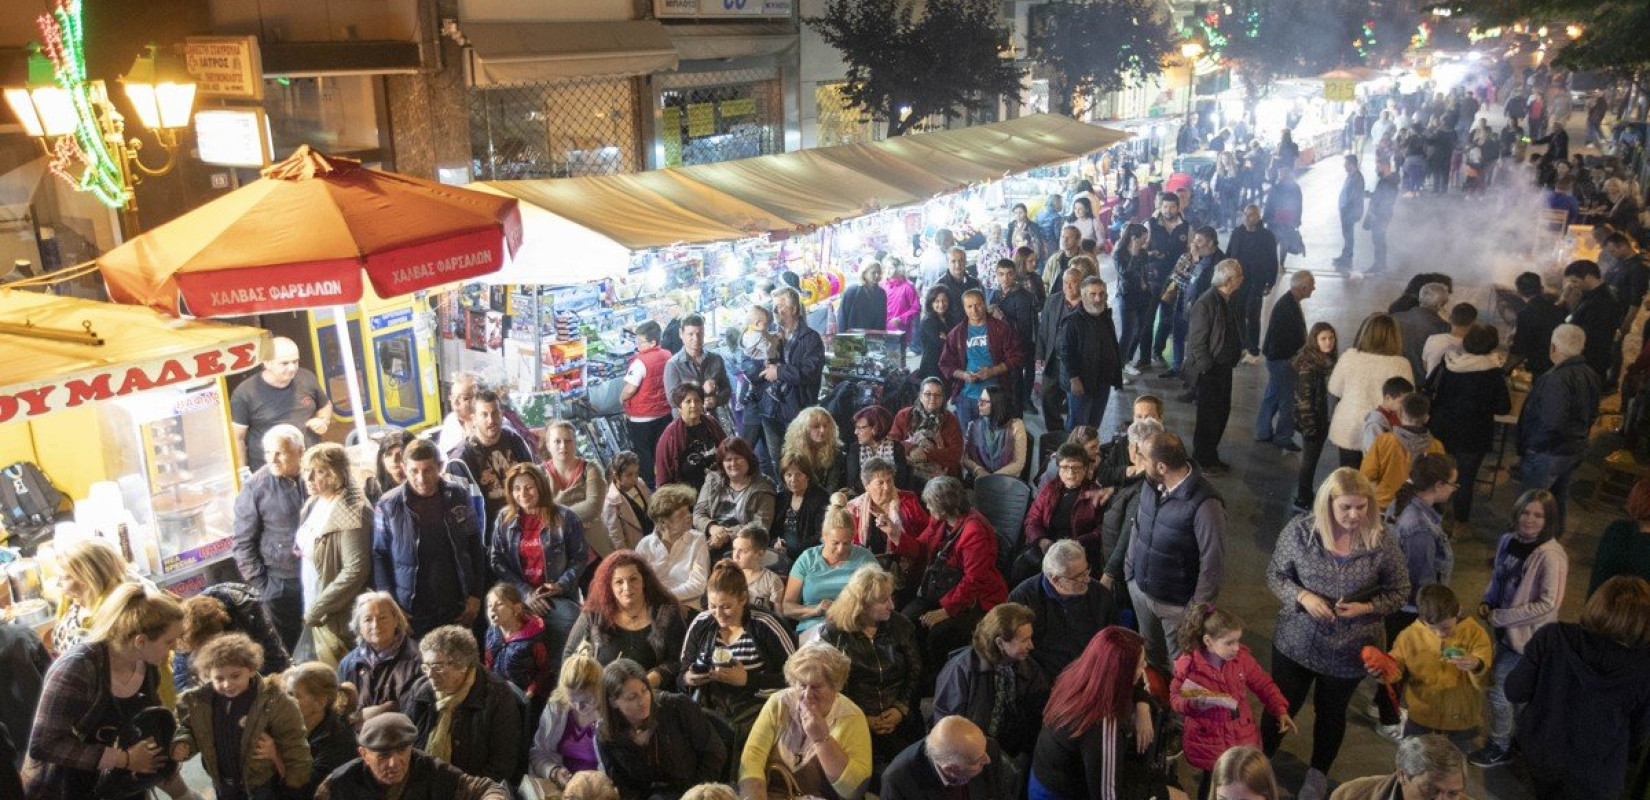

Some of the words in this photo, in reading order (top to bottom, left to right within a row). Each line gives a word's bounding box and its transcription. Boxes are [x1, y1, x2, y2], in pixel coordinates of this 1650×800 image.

[200, 57, 230, 68] ΙΑΤΡΟΣ
[391, 264, 435, 284] ΧΑΛΒΑΣ
[436, 250, 492, 274] ΦΑΡΣΑΛΩΝ
[210, 285, 267, 306] ΧΑΛΒΑΣ
[268, 280, 342, 300] ΦΑΡΣΑΛΩΝ
